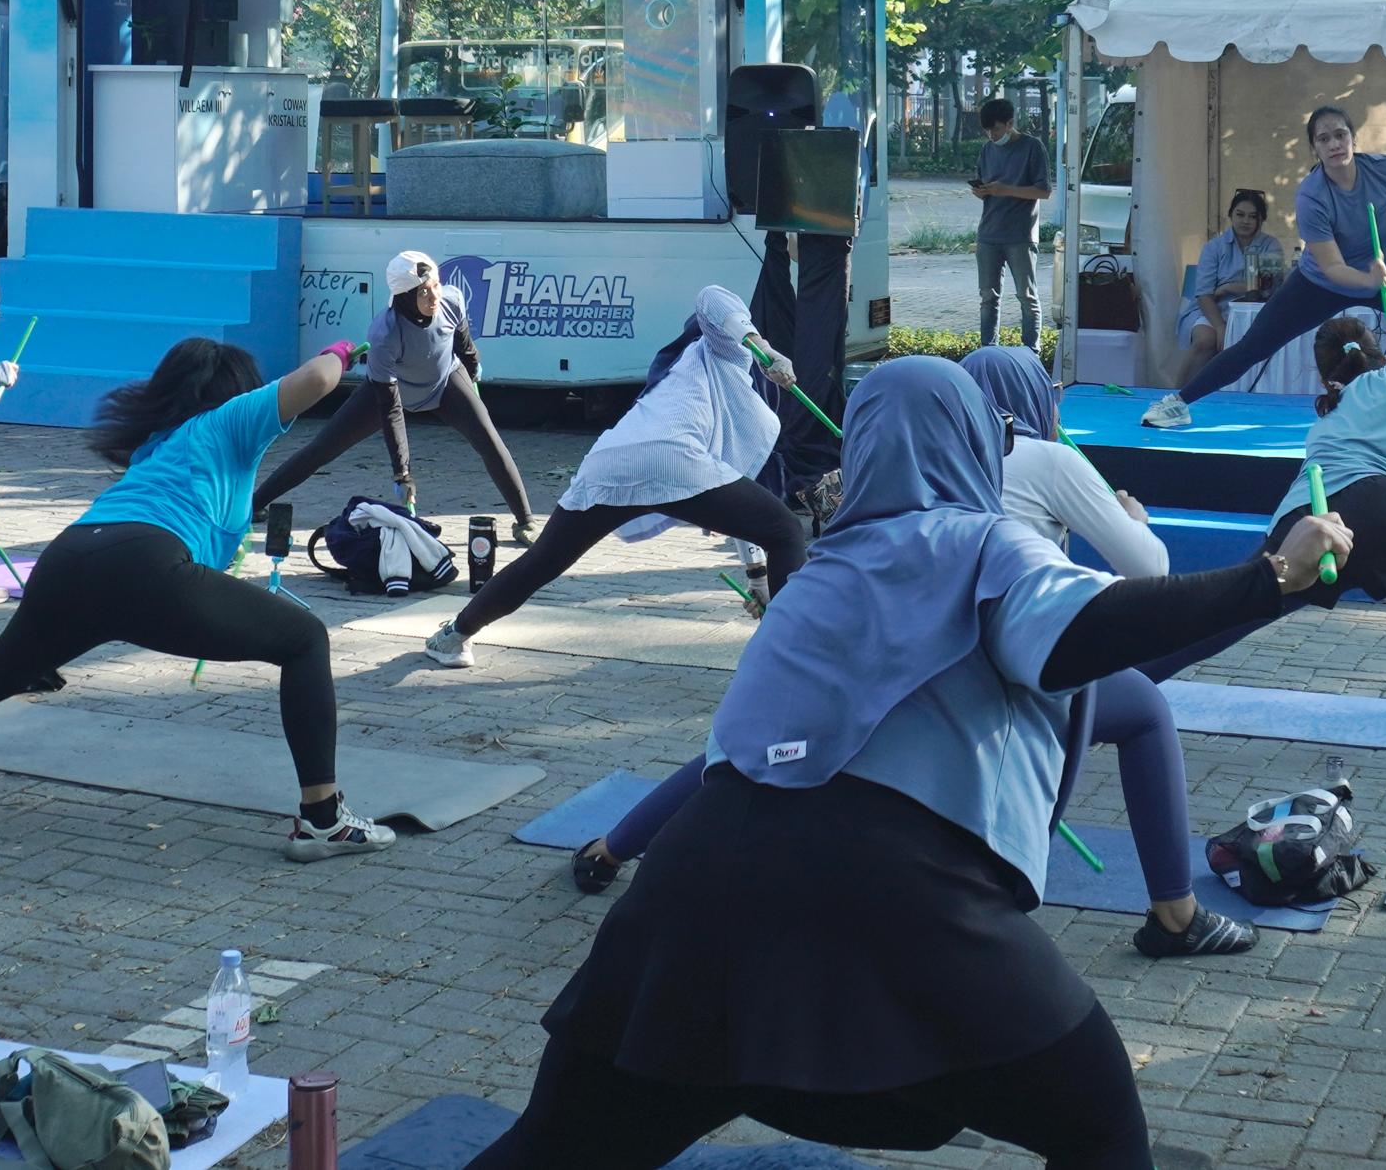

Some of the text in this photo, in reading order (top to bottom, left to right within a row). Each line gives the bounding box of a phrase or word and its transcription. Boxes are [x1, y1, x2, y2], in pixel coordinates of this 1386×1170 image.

[505, 275, 634, 306] HALAL
[503, 305, 634, 320] WATER PURIFIER
[499, 318, 634, 338] FROM KOREA
